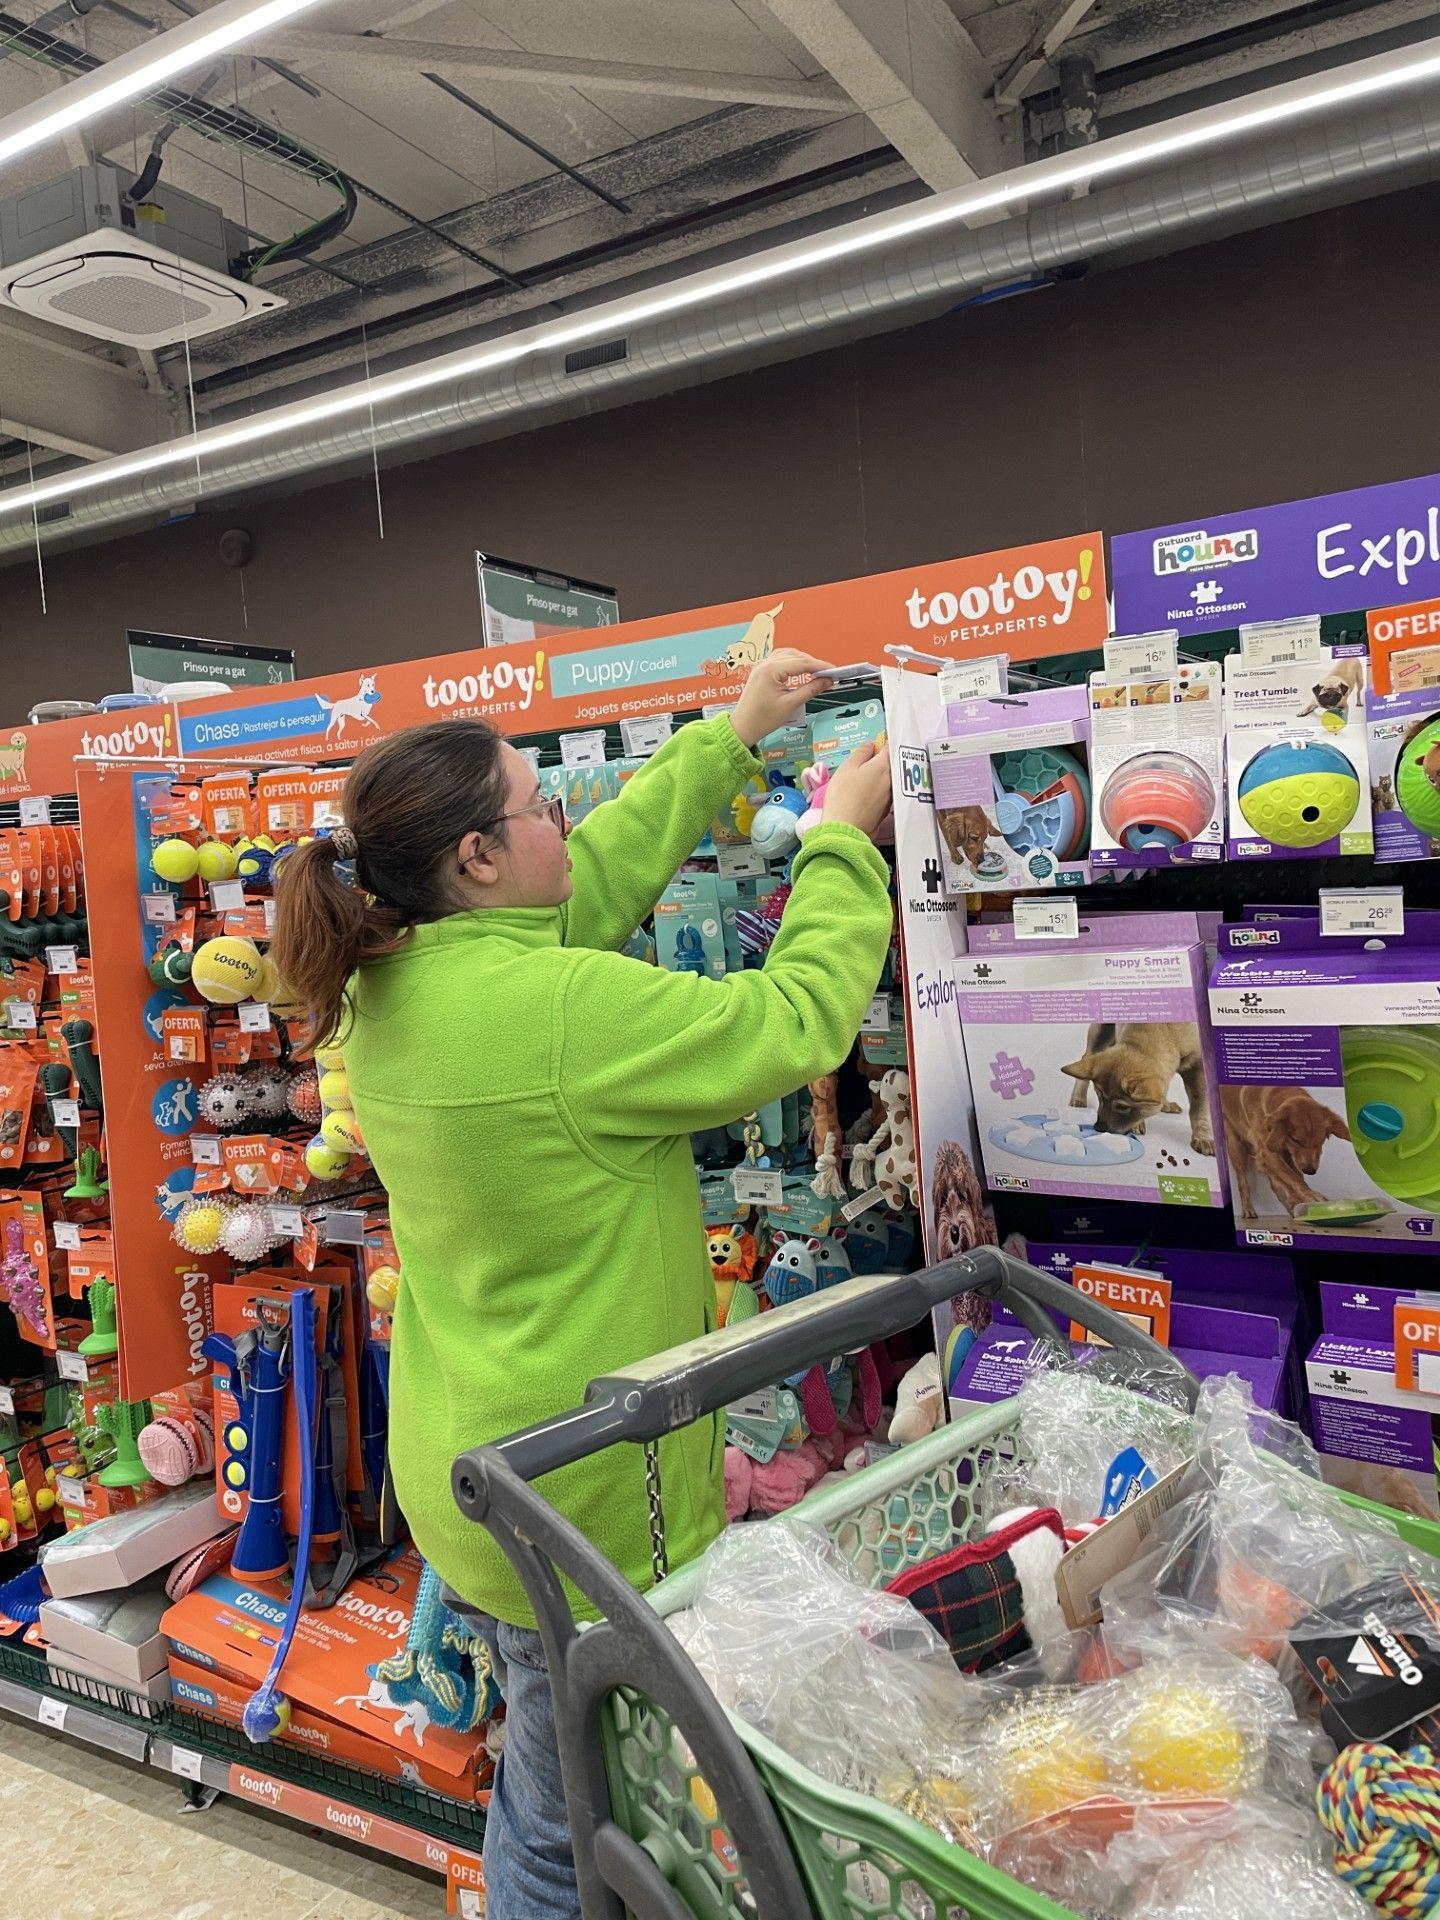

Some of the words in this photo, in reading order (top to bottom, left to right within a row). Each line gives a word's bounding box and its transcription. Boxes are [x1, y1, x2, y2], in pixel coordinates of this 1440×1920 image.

[1158, 533, 1202, 547] outward
[1317, 507, 1440, 586] Expl
[1159, 533, 1255, 572] hound
[905, 549, 1094, 629] tootoy!
[526, 594, 548, 609] Pinso
[549, 601, 560, 612] per
[561, 604, 566, 612] a
[567, 605, 579, 617] gat
[1167, 609, 1194, 620] Nina
[1195, 602, 1247, 615] Ottosson
[933, 634, 948, 646] by
[1145, 652, 1159, 662] 16
[183, 662, 208, 675] Pinso
[209, 665, 224, 677] per
[231, 668, 246, 678] gat
[422, 650, 545, 710] tootoy!
[974, 676, 985, 687] 16
[1234, 690, 1259, 698] Treat
[1261, 687, 1298, 696] Tumble
[575, 703, 619, 719] Joguets
[621, 692, 674, 714] especials
[677, 691, 696, 704] per
[699, 684, 717, 698] als
[280, 717, 286, 728] &
[287, 712, 325, 728] perseguir
[81, 713, 172, 757] tootoy!
[1374, 725, 1404, 738] hound
[264, 747, 298, 760] activitat
[335, 740, 358, 751] saltar
[206, 786, 246, 801] OFERTA
[263, 780, 307, 798] OFERTA
[1239, 843, 1271, 854] hound
[910, 899, 926, 914] Nina
[927, 899, 957, 914] Ottosson
[1368, 908, 1384, 919] 26
[1049, 914, 1061, 924] 15
[1232, 931, 1278, 945] hound
[214, 951, 258, 980] tootoy!
[1105, 958, 1140, 968] Puppy
[1144, 956, 1181, 966] Smart
[164, 1017, 201, 1030] OFERTA
[144, 1061, 165, 1071] seva
[163, 1150, 171, 1160] el
[226, 1143, 266, 1158] OFERTA
[995, 1176, 1029, 1188] hound
[1418, 1221, 1426, 1231] 1
[1248, 1232, 1292, 1245] hound
[1077, 1278, 1165, 1308] OFERTA
[1320, 1342, 1364, 1352] Lickin'
[982, 1353, 1002, 1361] Dog
[1334, 1385, 1368, 1394] Ottosson
[235, 1592, 287, 1623] Chase
[299, 1613, 316, 1627] Ball
[316, 1620, 358, 1645] Launcher
[176, 1642, 213, 1665] Chase
[177, 1683, 213, 1705] Chase
[240, 1773, 283, 1805] tootoy!
[326, 1804, 373, 1838] tootoy!
